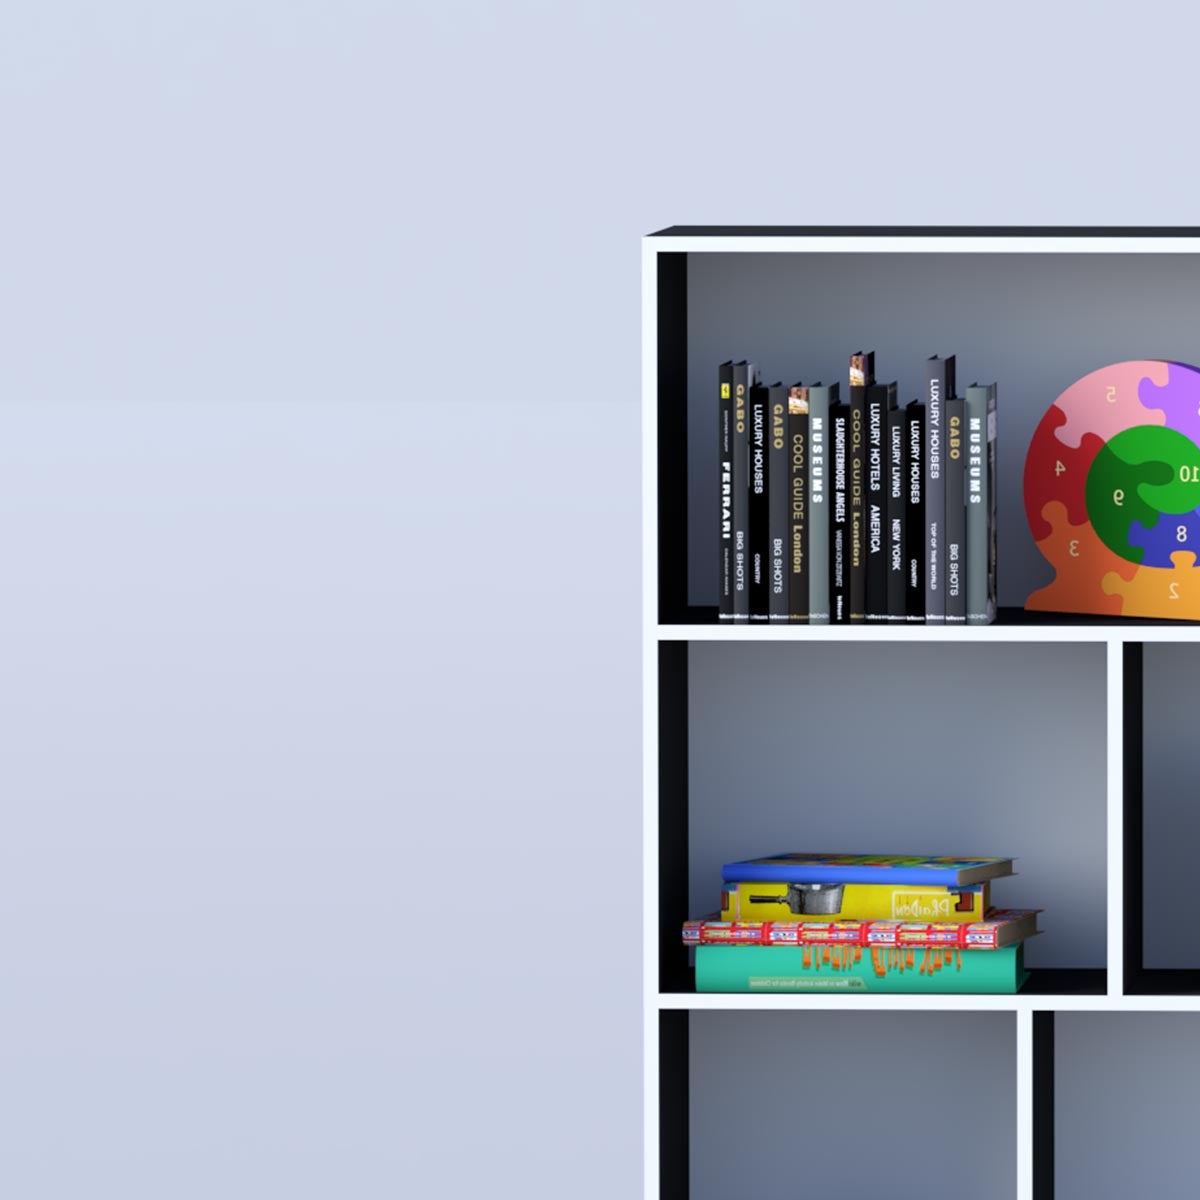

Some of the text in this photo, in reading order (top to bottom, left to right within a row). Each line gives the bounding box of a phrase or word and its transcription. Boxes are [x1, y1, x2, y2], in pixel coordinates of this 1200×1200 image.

[736, 384, 744, 433] GABO
[773, 404, 784, 449] GABO
[930, 379, 939, 479] LUXURY HOUSES
[950, 416, 960, 460] GABO
[754, 404, 763, 494] LUXURY HOUSES
[812, 418, 822, 503] MUSEUMS
[835, 418, 845, 490] SLAUGHTERHOUSE
[870, 403, 880, 491] LUXURY HOTELS
[892, 426, 901, 498] LUXURY LIVING
[911, 420, 920, 504] LUXURY HOUSES
[970, 418, 980, 504] MUSEUMS
[722, 462, 731, 539] FERRARI
[793, 434, 803, 573] COOL GUIDE London
[835, 492, 845, 522] ANGELS
[853, 409, 861, 566] COOL GUIDE London
[736, 531, 744, 590] BIG SHOTS
[870, 505, 880, 553] AMERICA
[892, 519, 901, 570] NEW YORK
[931, 538, 937, 548] OF
[773, 538, 783, 593] BIG SHOTS
[950, 544, 959, 596] BIG SHOTS
